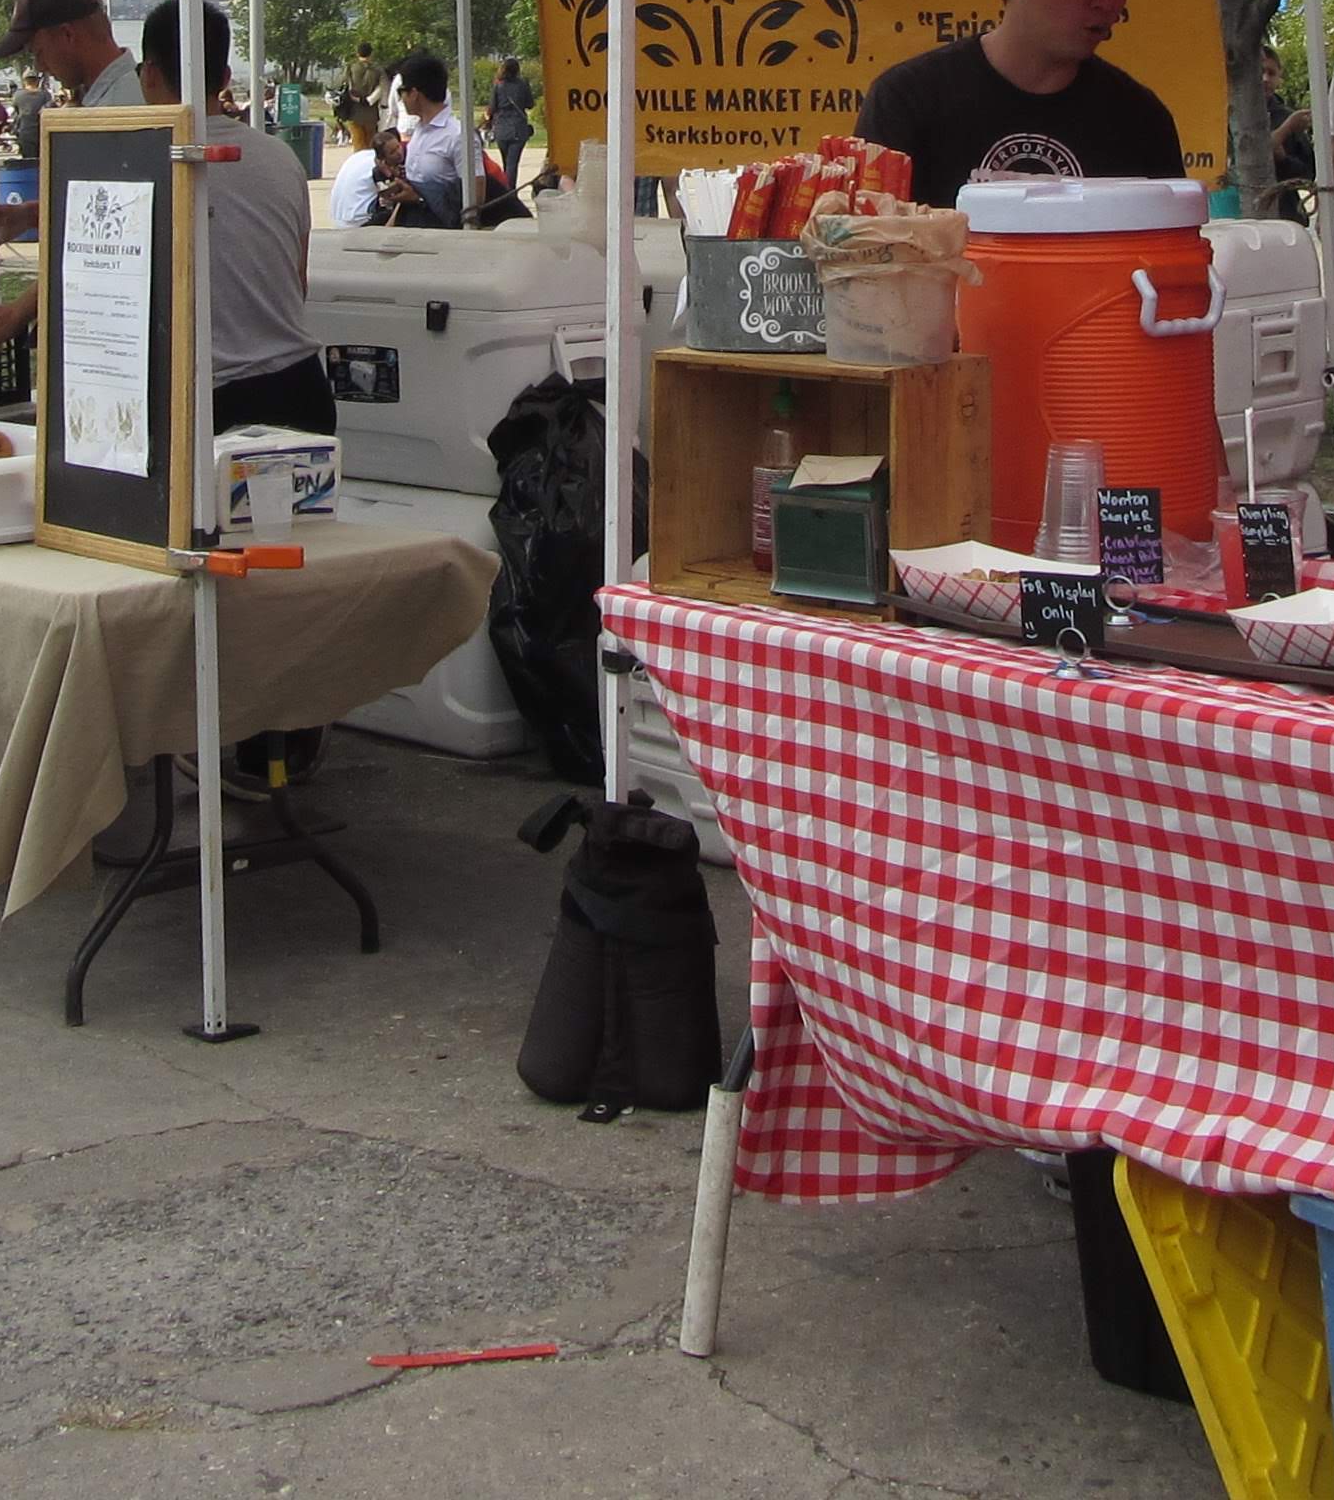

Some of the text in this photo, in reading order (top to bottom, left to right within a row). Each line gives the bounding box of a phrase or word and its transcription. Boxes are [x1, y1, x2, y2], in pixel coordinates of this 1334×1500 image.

[705, 88, 801, 112] MARKET
[645, 123, 802, 148] Starksboro, VT
[992, 143, 1071, 176] BROOKLYN
[1098, 490, 1149, 507] Wonton
[1050, 581, 1097, 607] Display
[1042, 604, 1074, 628] Only
